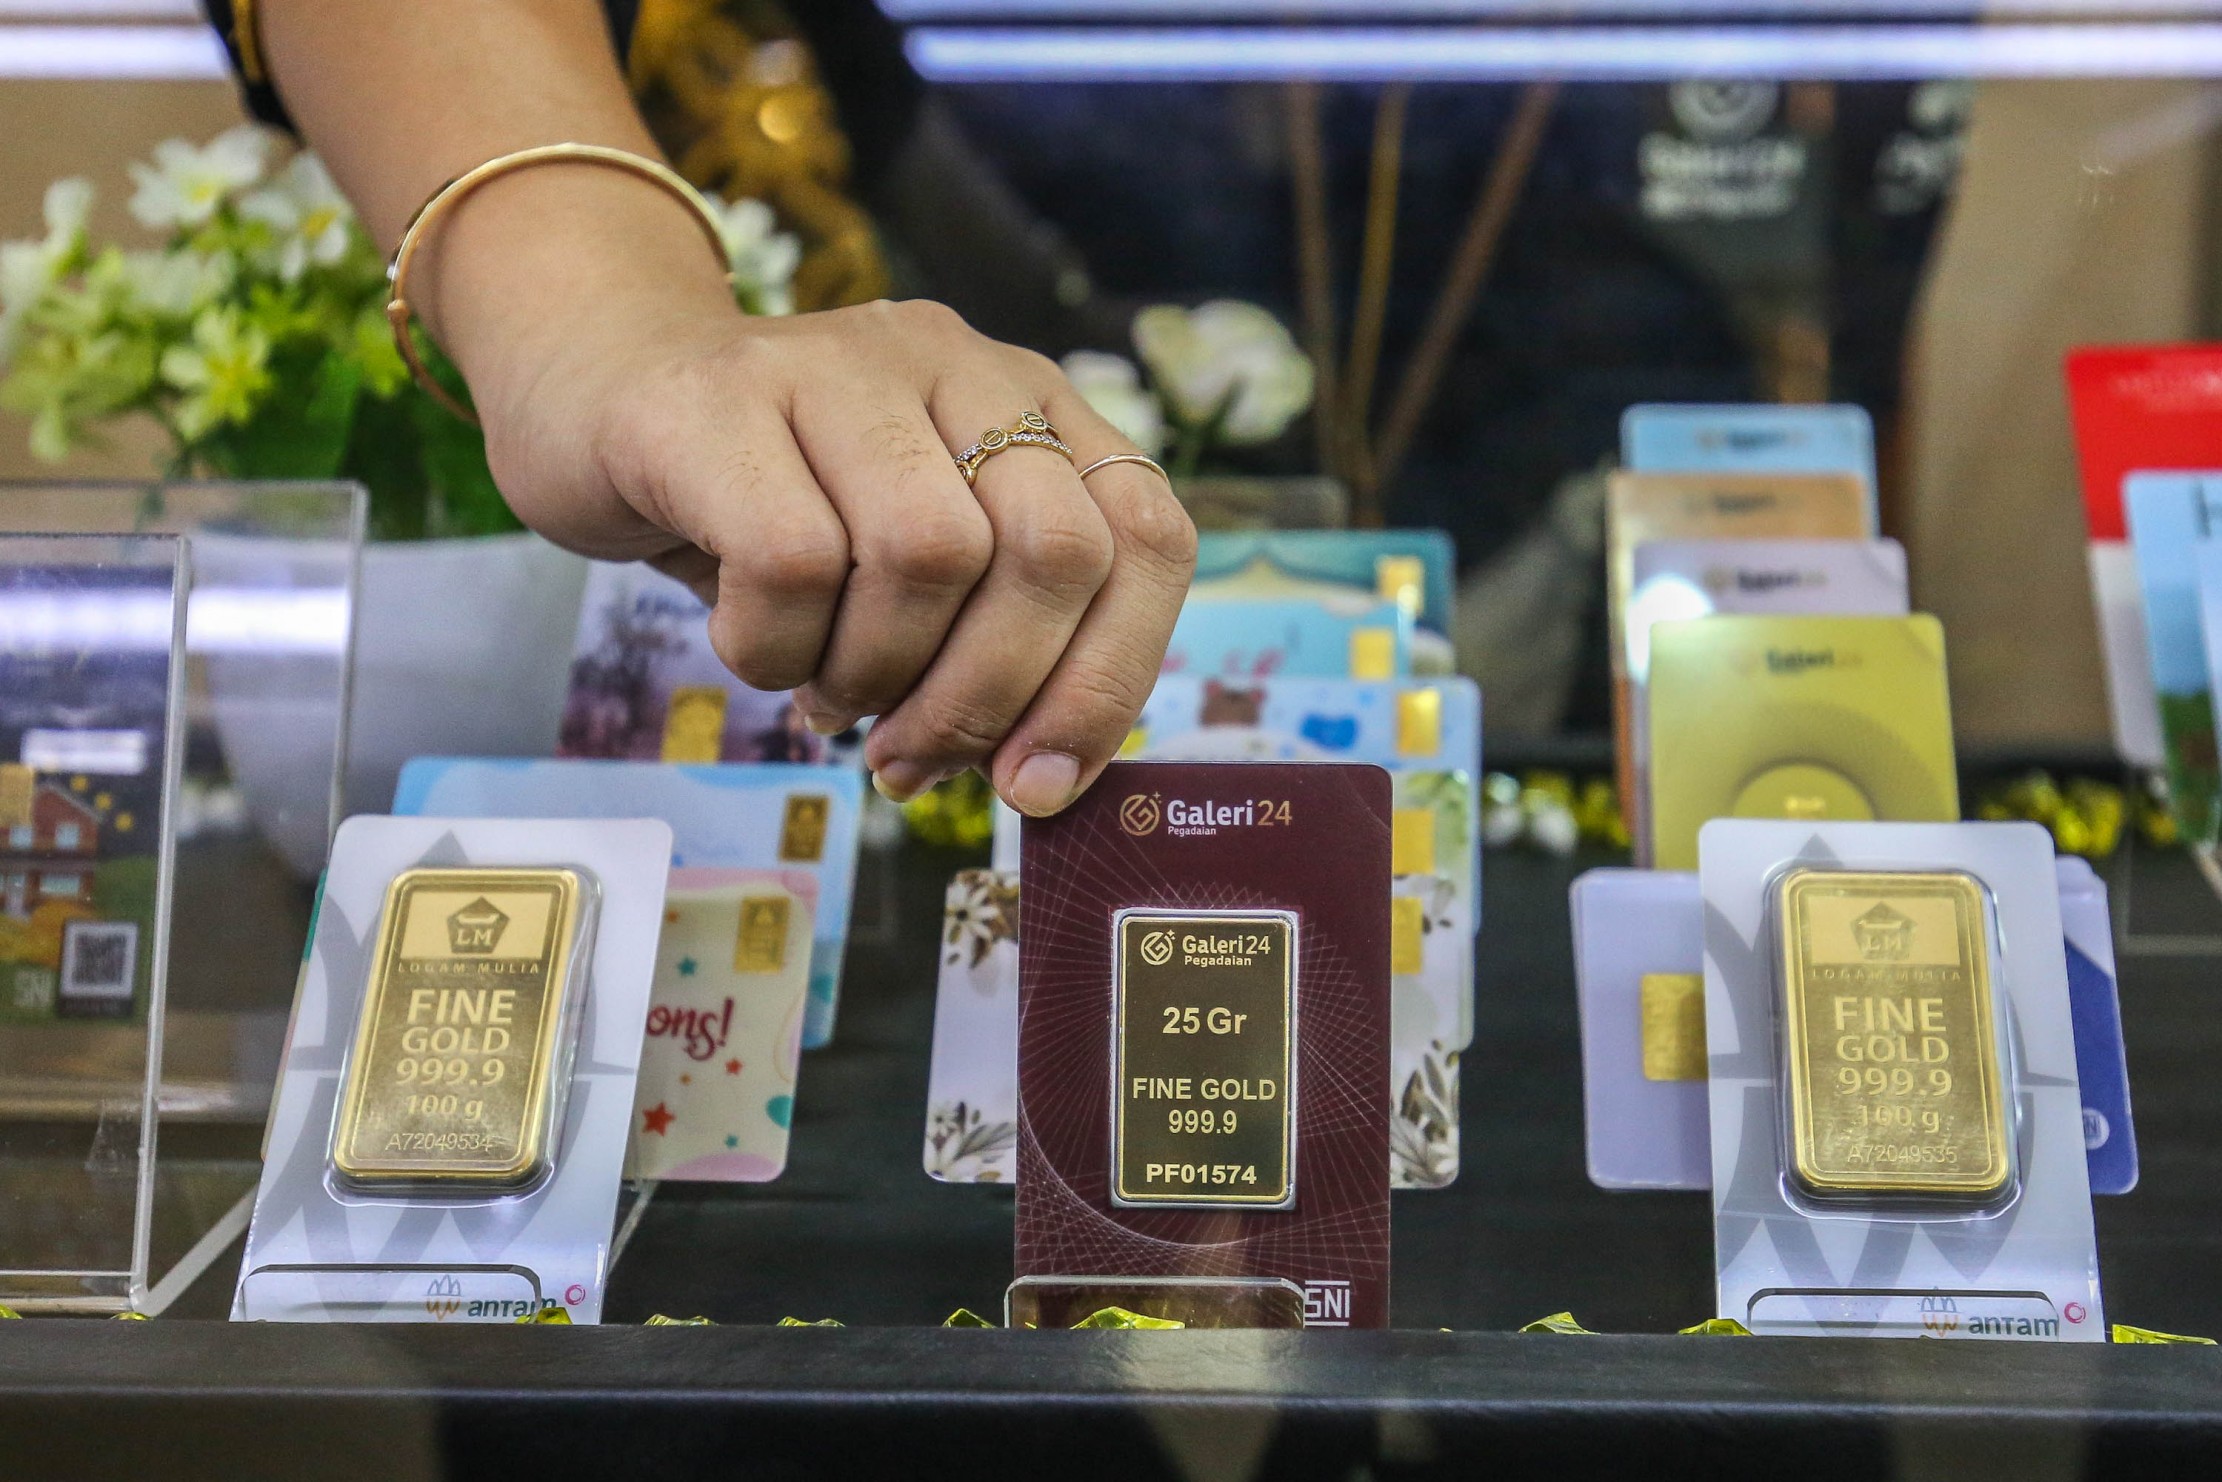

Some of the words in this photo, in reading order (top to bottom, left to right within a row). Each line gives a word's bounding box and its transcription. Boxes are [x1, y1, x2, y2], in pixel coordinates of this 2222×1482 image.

[1167, 826, 1217, 838] Pegadaian
[455, 929, 495, 946] LM
[398, 962, 467, 974] LOGAM
[477, 962, 541, 974] MULIA
[1184, 955, 1252, 968] Pegadaian
[406, 989, 516, 1025] FINE
[1834, 996, 1947, 1032] FINE
[1162, 1007, 1200, 1034] 25
[1206, 1007, 1247, 1035] Gr
[401, 1027, 510, 1054] GOLD
[1836, 1035, 1949, 1063] GOLD
[396, 1058, 506, 1087] 999.9
[1837, 1067, 1952, 1098] 999.9
[1133, 1078, 1192, 1100] FINE
[1200, 1078, 1277, 1101] GOLD
[405, 1094, 457, 1117] 100
[465, 1099, 484, 1121] g
[1168, 1109, 1238, 1135] 999.9
[1921, 1110, 1940, 1134] g
[1146, 1164, 1257, 1185] PF01574
[1304, 1288, 1350, 1318] SNI
